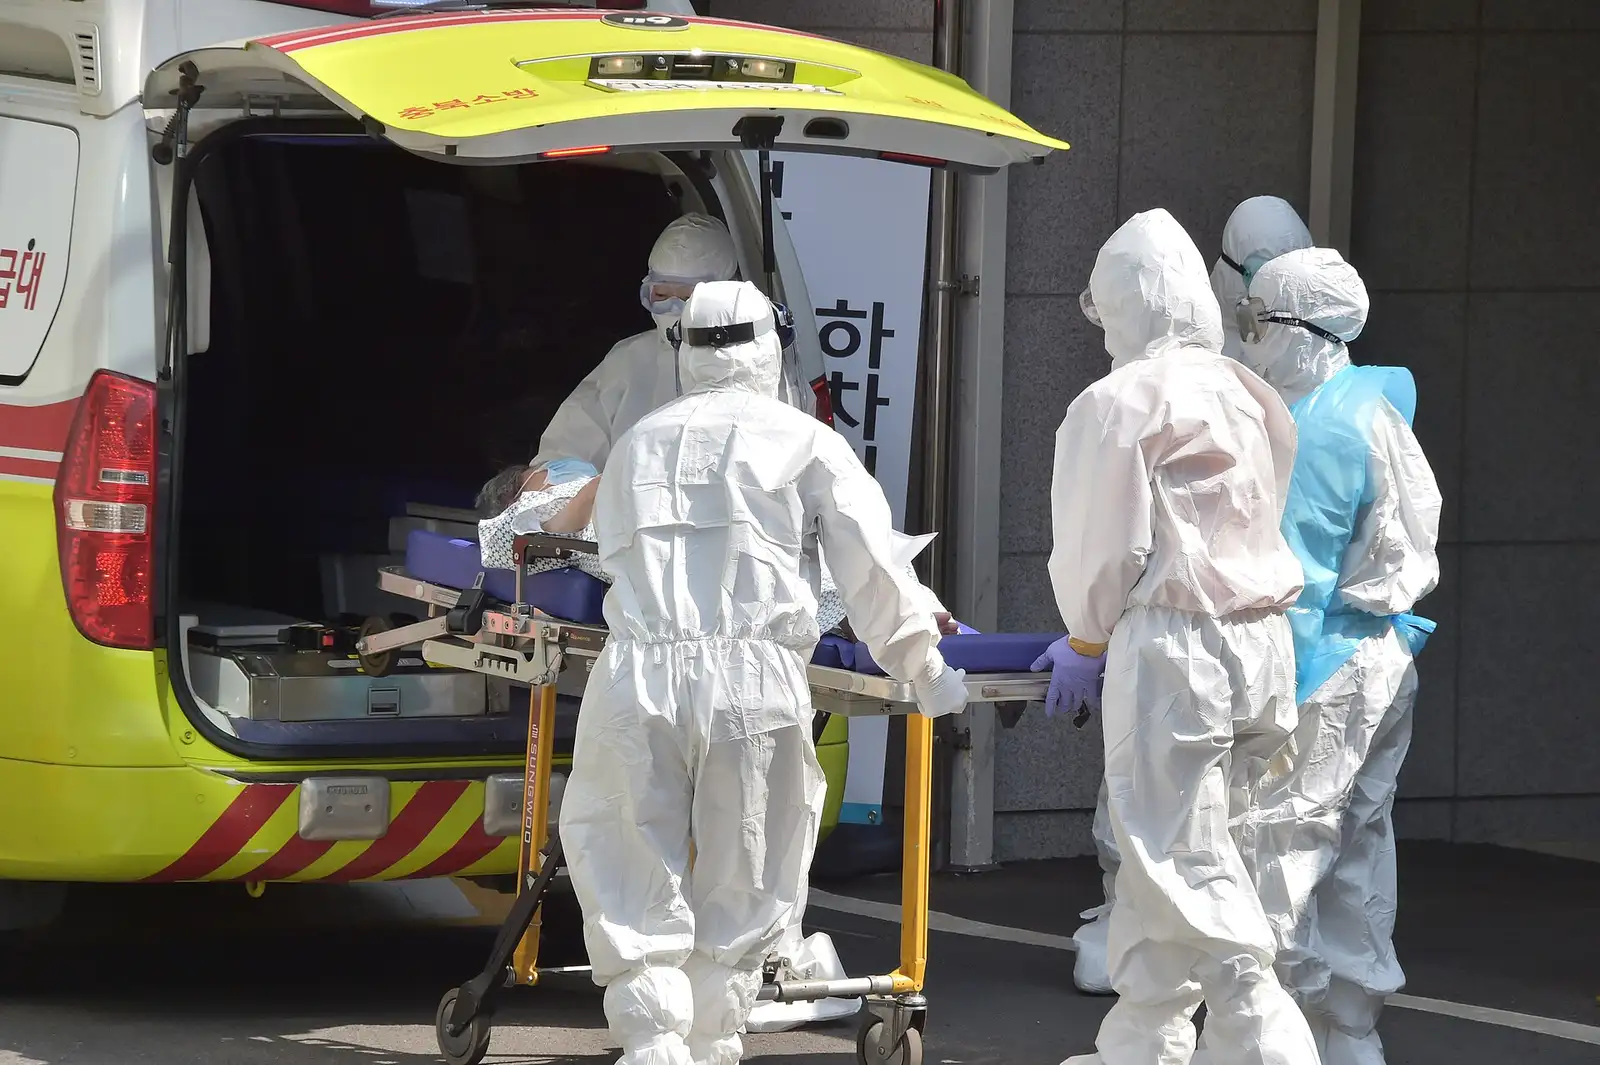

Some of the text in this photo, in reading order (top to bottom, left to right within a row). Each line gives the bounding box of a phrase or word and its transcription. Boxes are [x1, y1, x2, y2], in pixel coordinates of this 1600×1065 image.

[622, 16, 672, 25] 119
[398, 88, 539, 119] 충북소방
[524, 743, 538, 844] SUNGWOO
